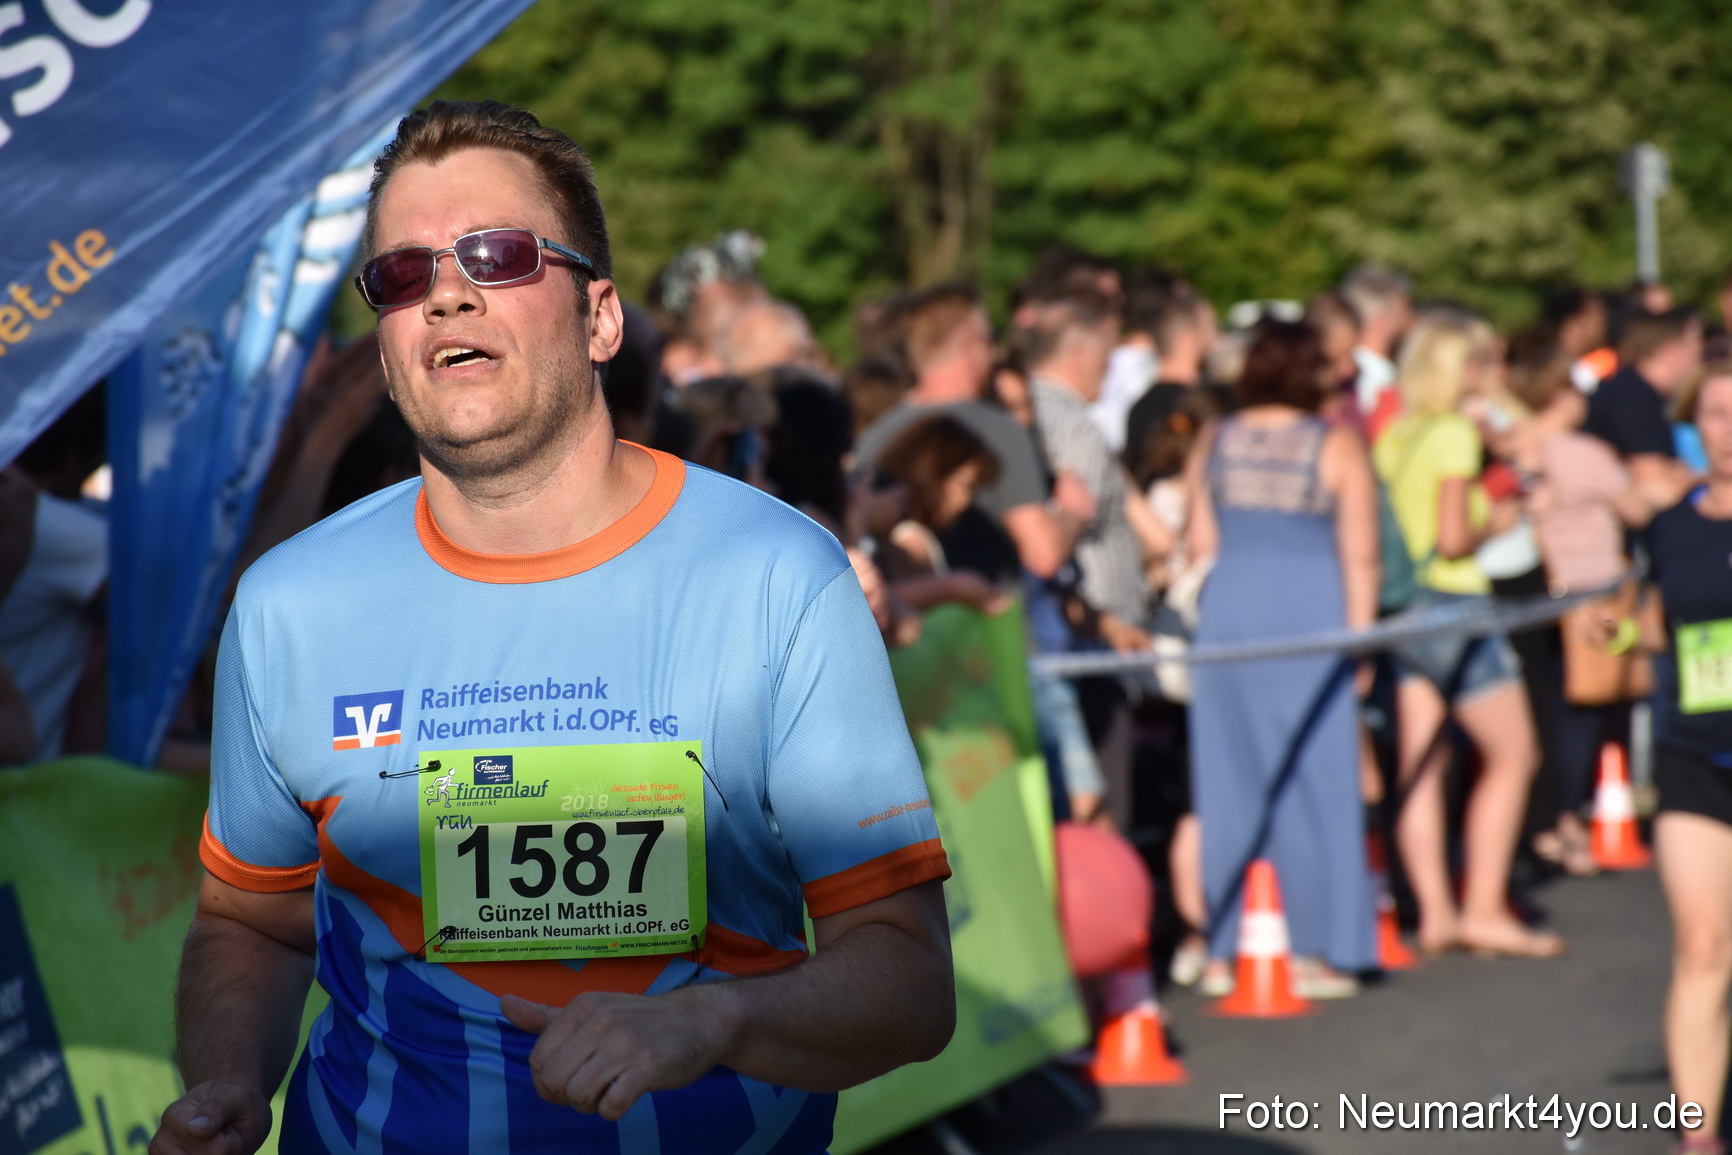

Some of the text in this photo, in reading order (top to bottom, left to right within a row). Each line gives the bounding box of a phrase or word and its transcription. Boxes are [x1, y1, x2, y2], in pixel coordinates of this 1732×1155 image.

[420, 676, 609, 710] Raiffeisenbank
[417, 707, 679, 741] Neumarkt i.d.OPf. eG
[480, 763, 508, 771] Fischer
[456, 779, 550, 799] firmenlauf
[609, 782, 679, 793] Gesunde Firmen
[626, 790, 687, 804] laufen länger!
[560, 794, 609, 811] 2018
[457, 819, 665, 899] 1587
[478, 900, 648, 922] Günzel Matthias
[543, 923, 611, 938] Neumarkt
[614, 920, 666, 935] i.d.OPf.
[670, 918, 690, 931] eG
